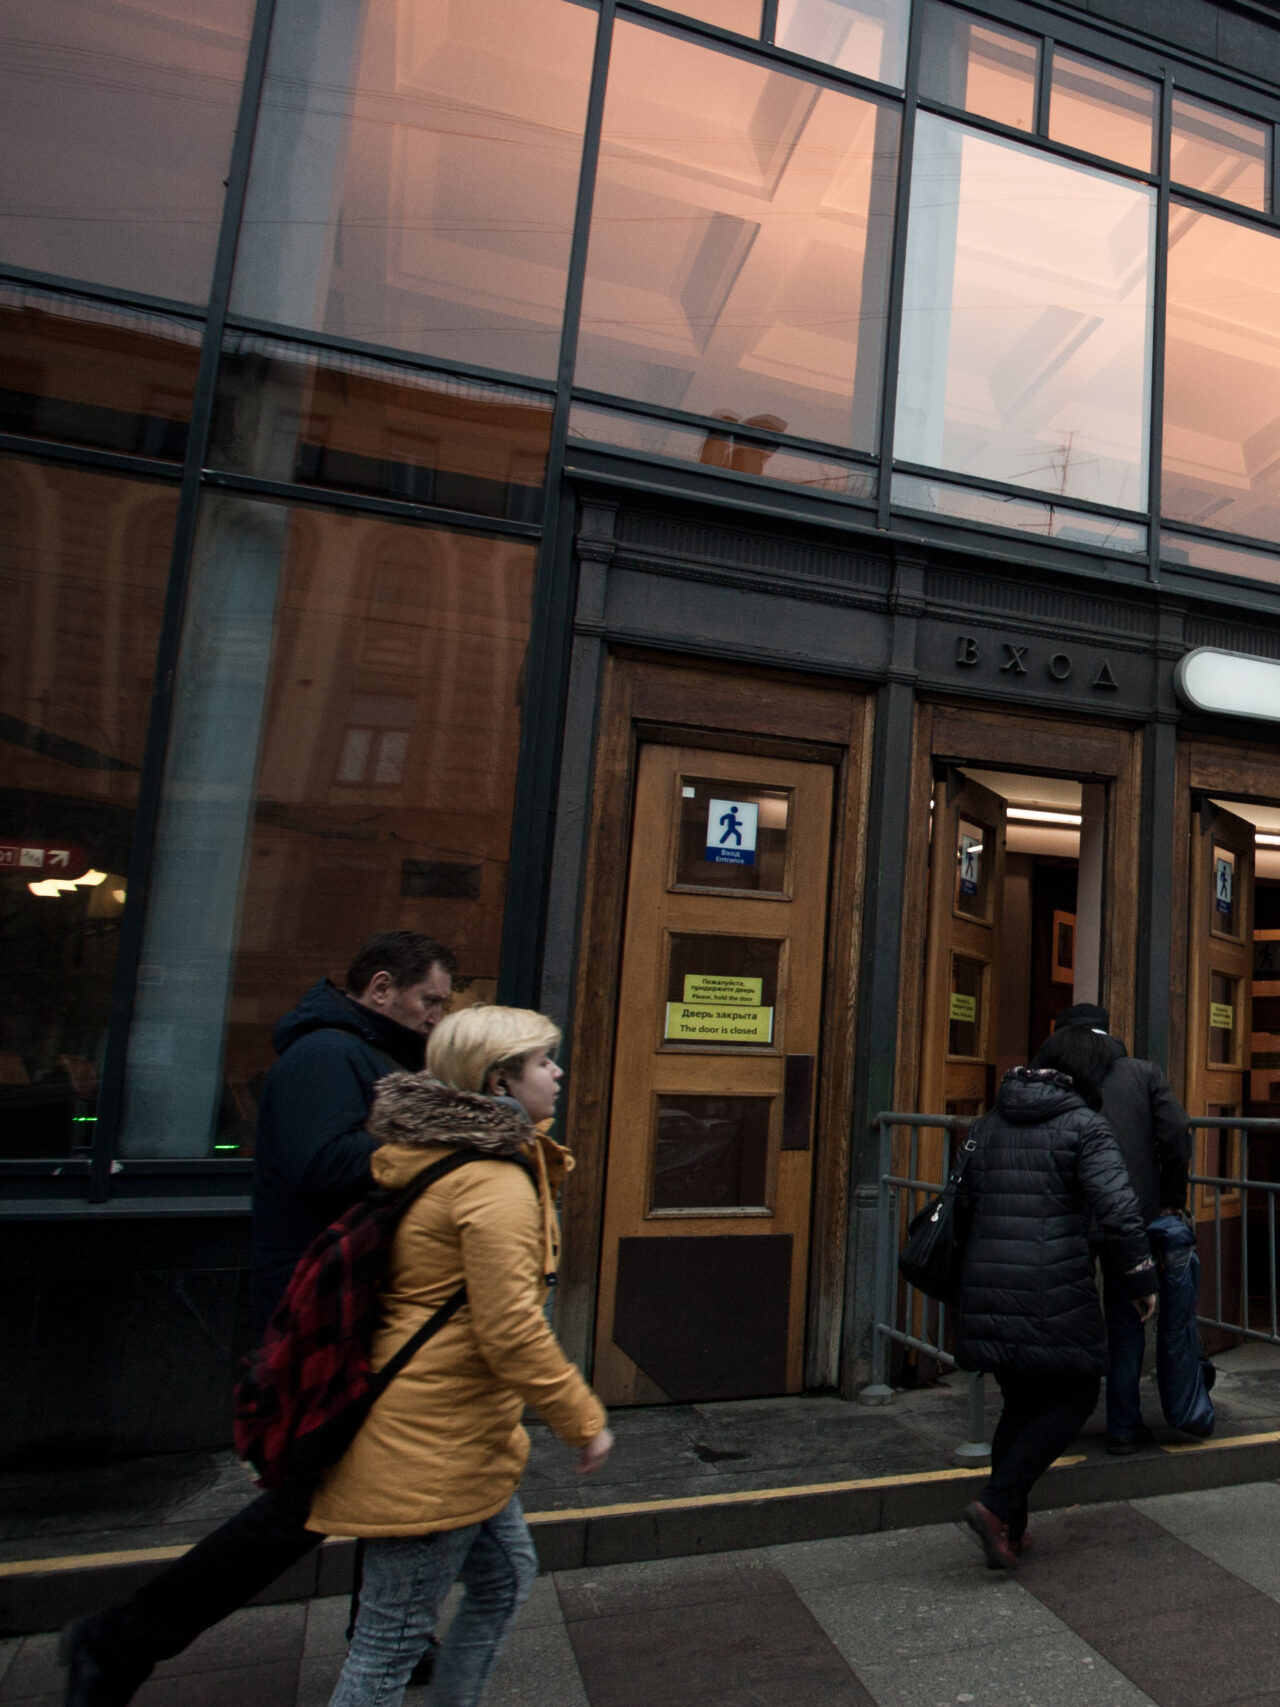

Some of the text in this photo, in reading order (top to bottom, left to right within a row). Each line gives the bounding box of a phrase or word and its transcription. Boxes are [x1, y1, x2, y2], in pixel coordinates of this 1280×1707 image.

[955, 636, 1118, 688] ВХОД
[721, 849, 741, 858] Вход
[715, 856, 745, 864] Entrance
[681, 1008, 757, 1021] Дверь закрыта
[680, 1024, 757, 1035] The door is closed
